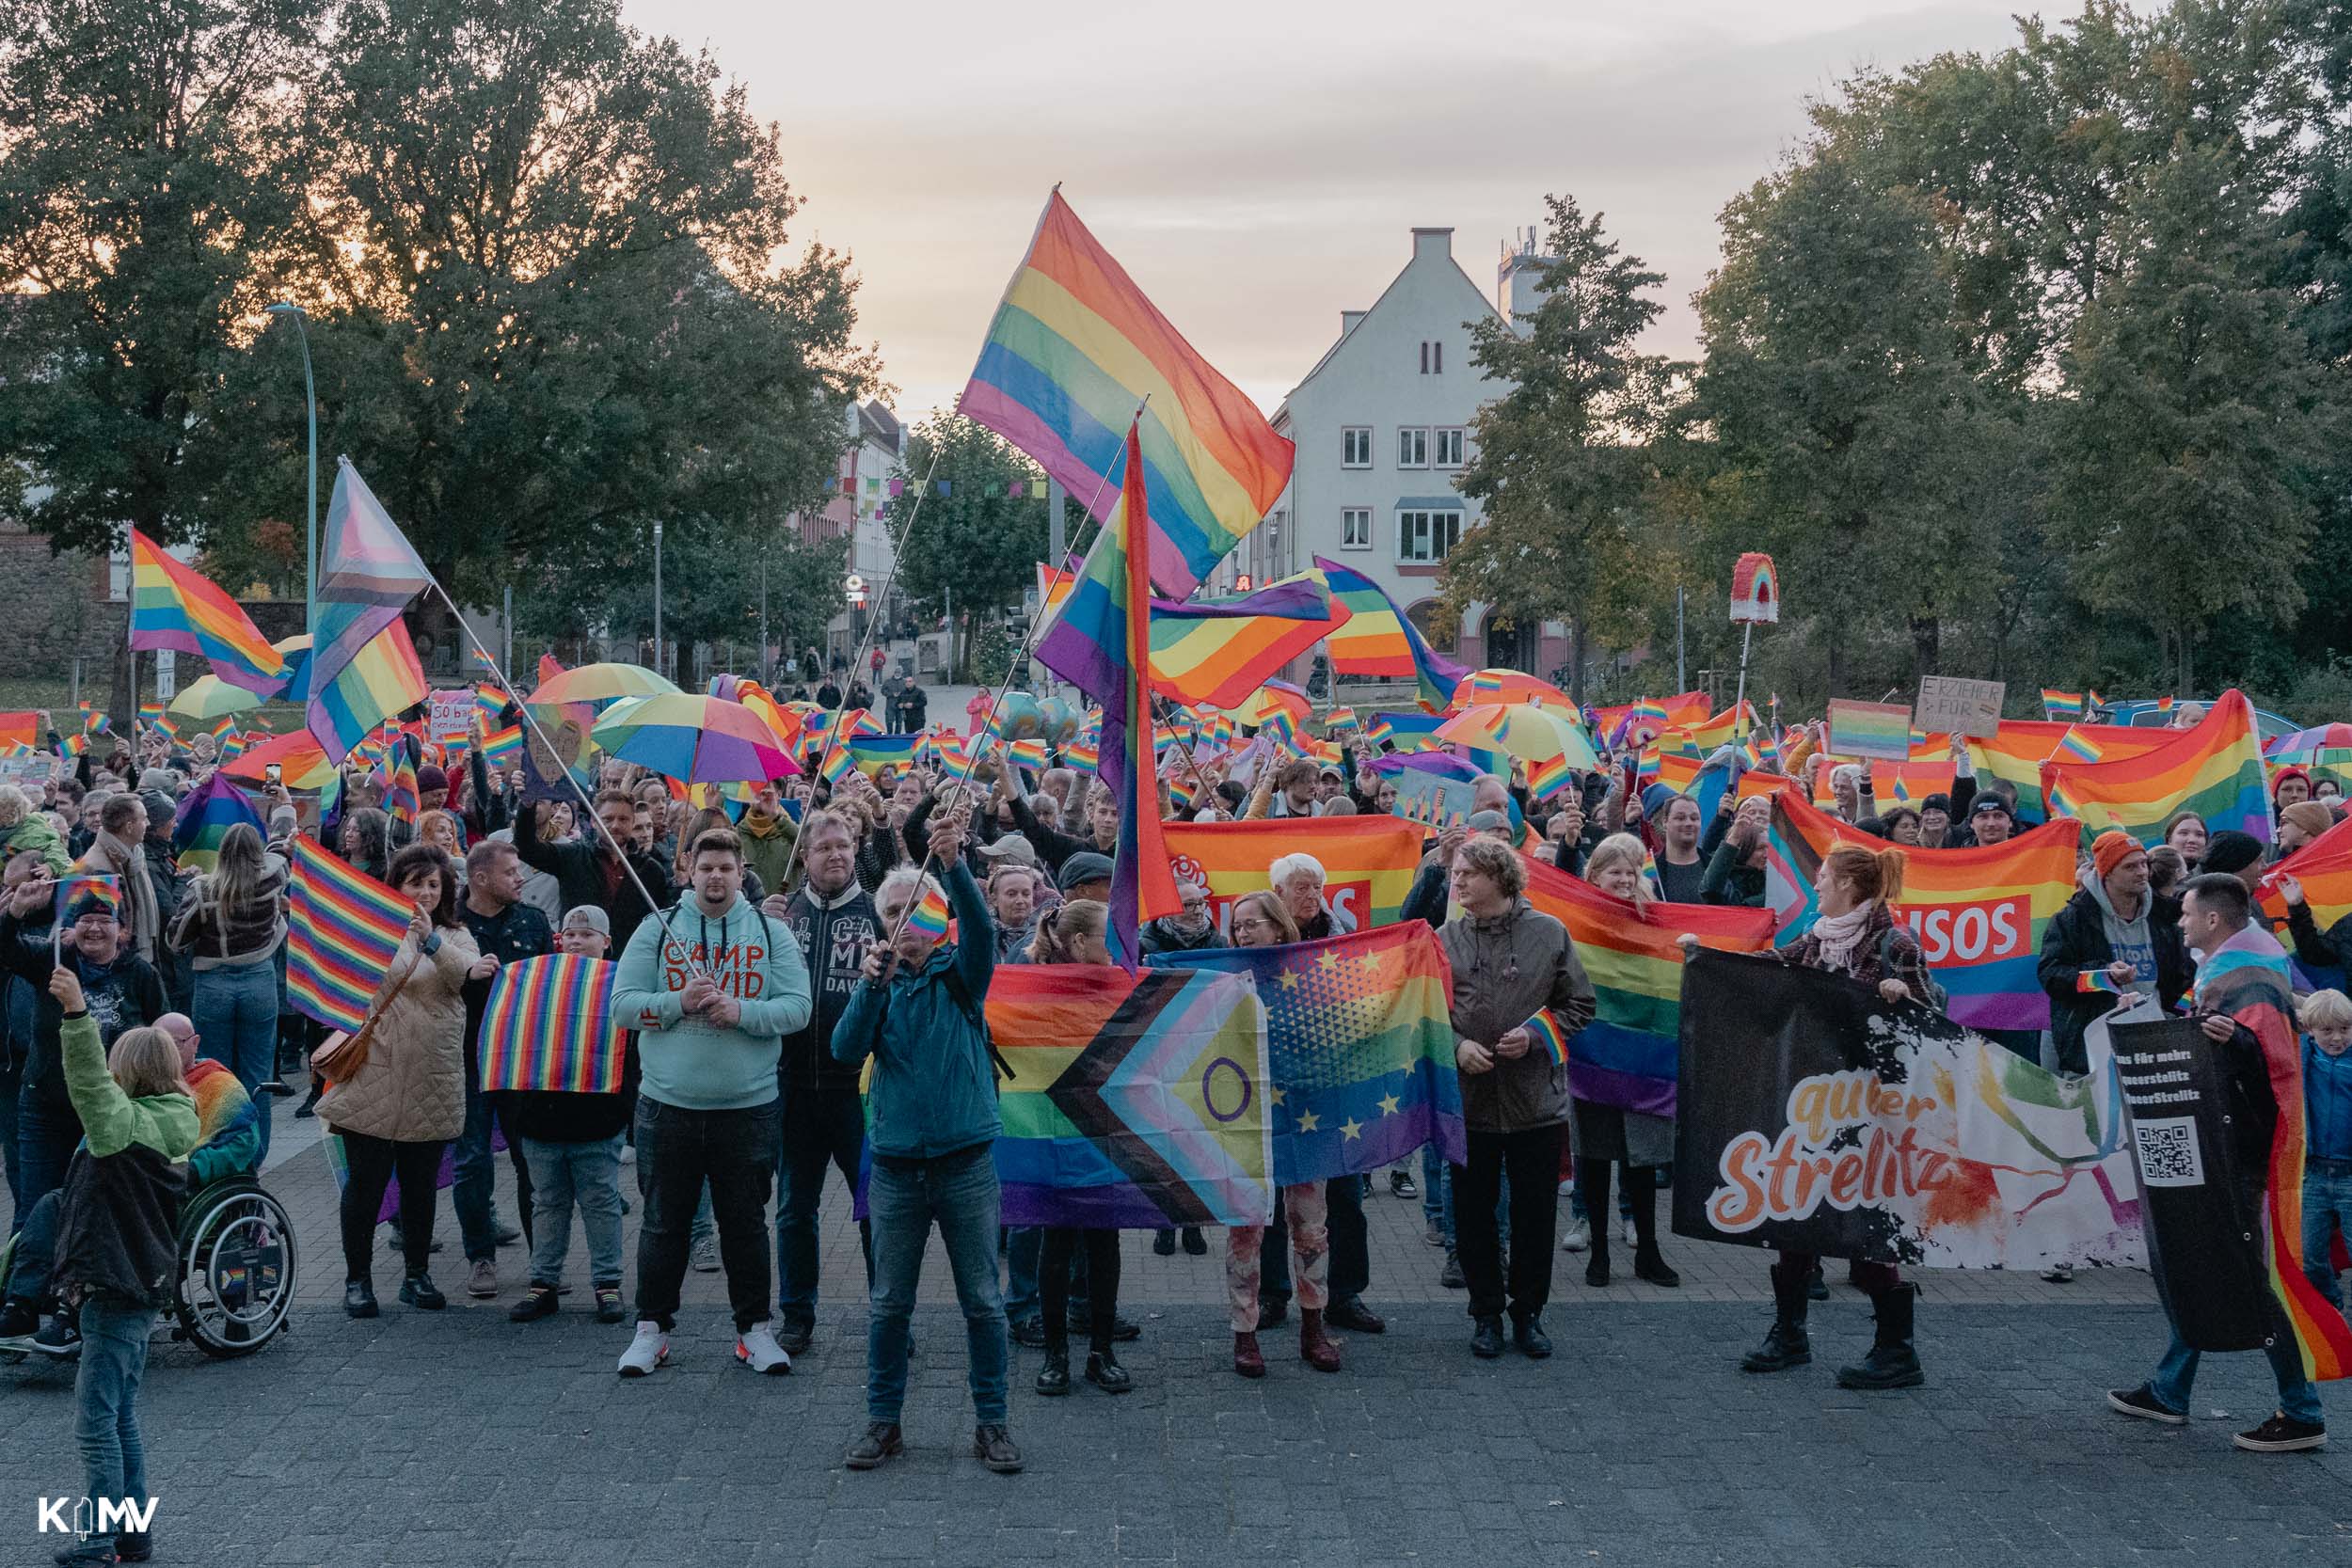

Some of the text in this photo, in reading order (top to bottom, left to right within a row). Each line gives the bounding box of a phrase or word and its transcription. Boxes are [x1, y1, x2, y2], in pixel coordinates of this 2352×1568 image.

[1922, 677, 2001, 702] ERZIEHER
[663, 941, 765, 970] CAMP
[665, 967, 765, 999] DVID
[825, 977, 858, 995] DAV
[2133, 1053, 2154, 1065] für
[2155, 1050, 2192, 1063] mehr:
[1714, 1128, 1954, 1226] Strelitz
